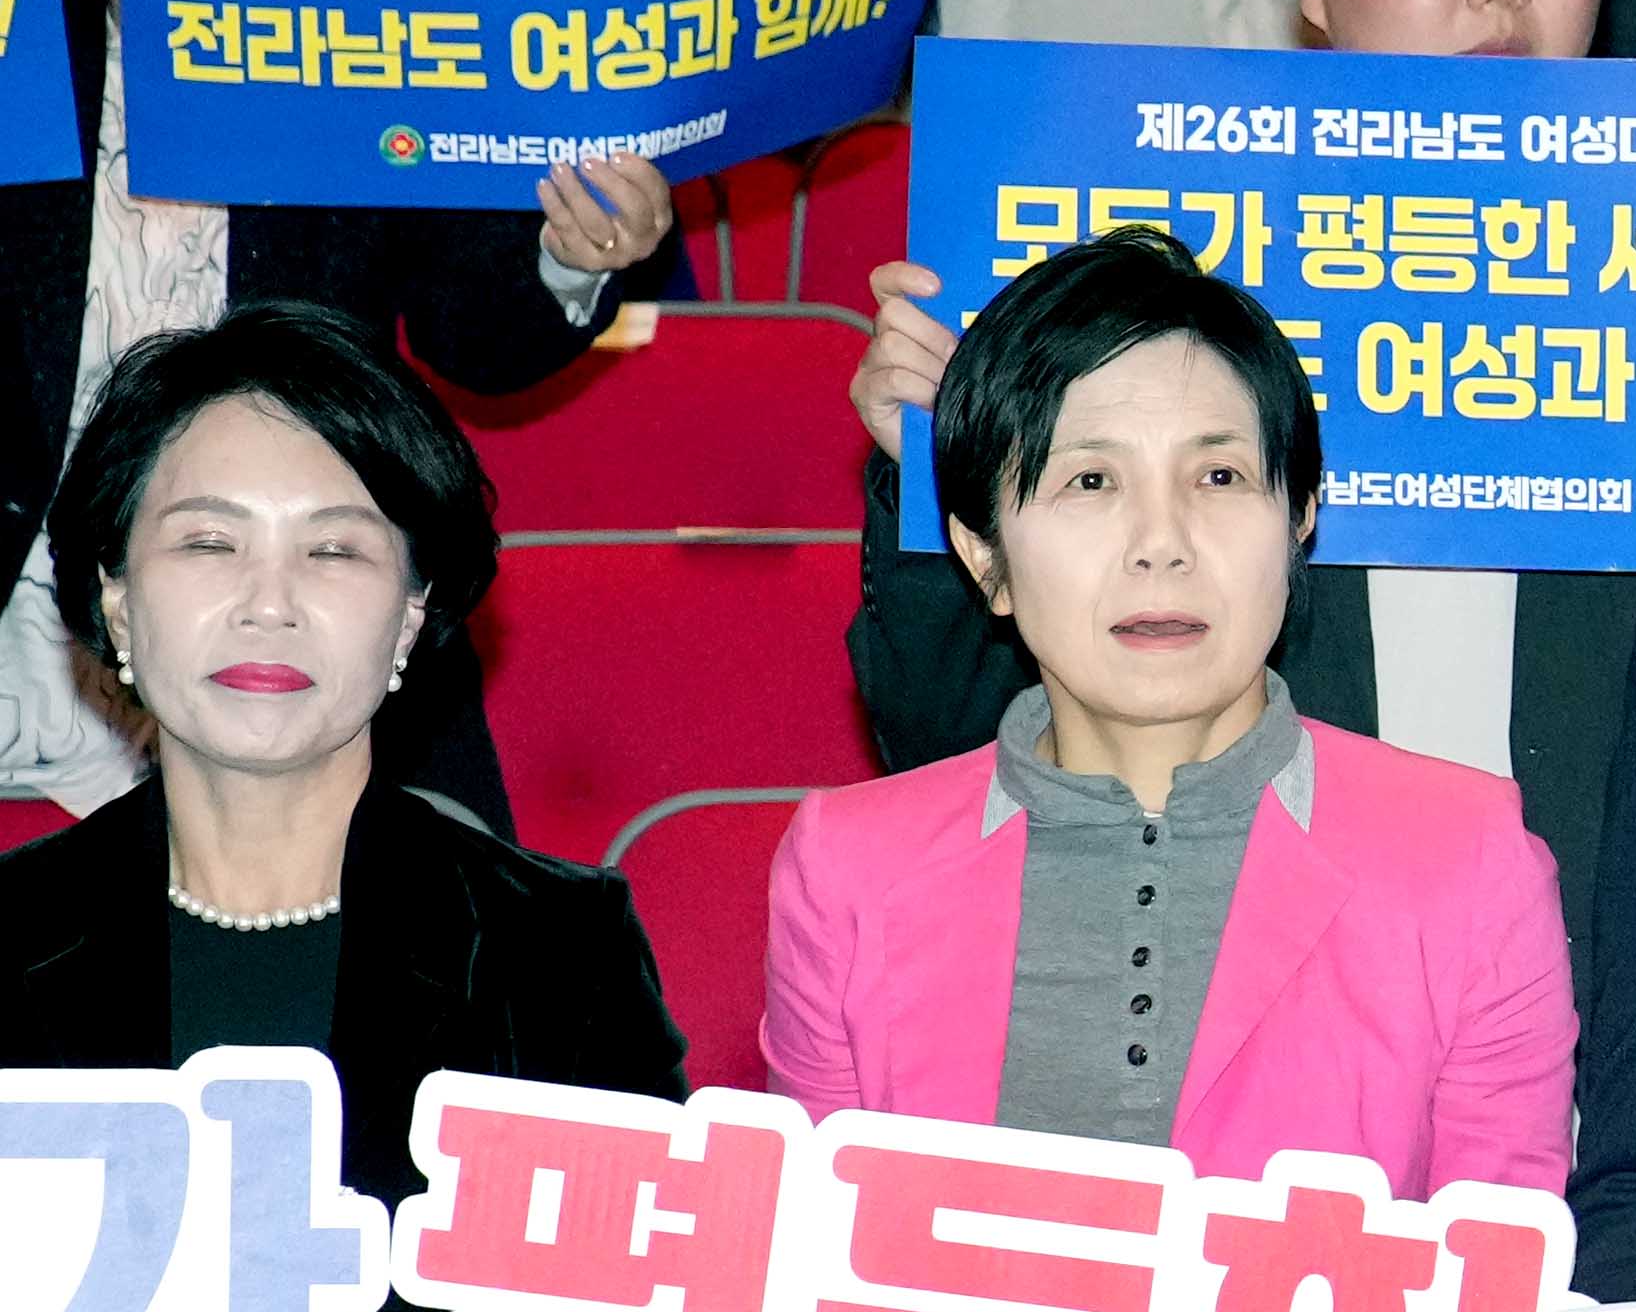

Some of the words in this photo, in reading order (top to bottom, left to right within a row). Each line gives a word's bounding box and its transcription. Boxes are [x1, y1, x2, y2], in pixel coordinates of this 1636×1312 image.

[167, 0, 488, 90] 전라남도
[429, 109, 727, 167] 전라남도여성단체협의회
[1135, 102, 1297, 155] 제26회
[1312, 108, 1506, 161] 전라남도
[1296, 194, 1577, 297] 평등한
[1357, 321, 1636, 423] 여성과
